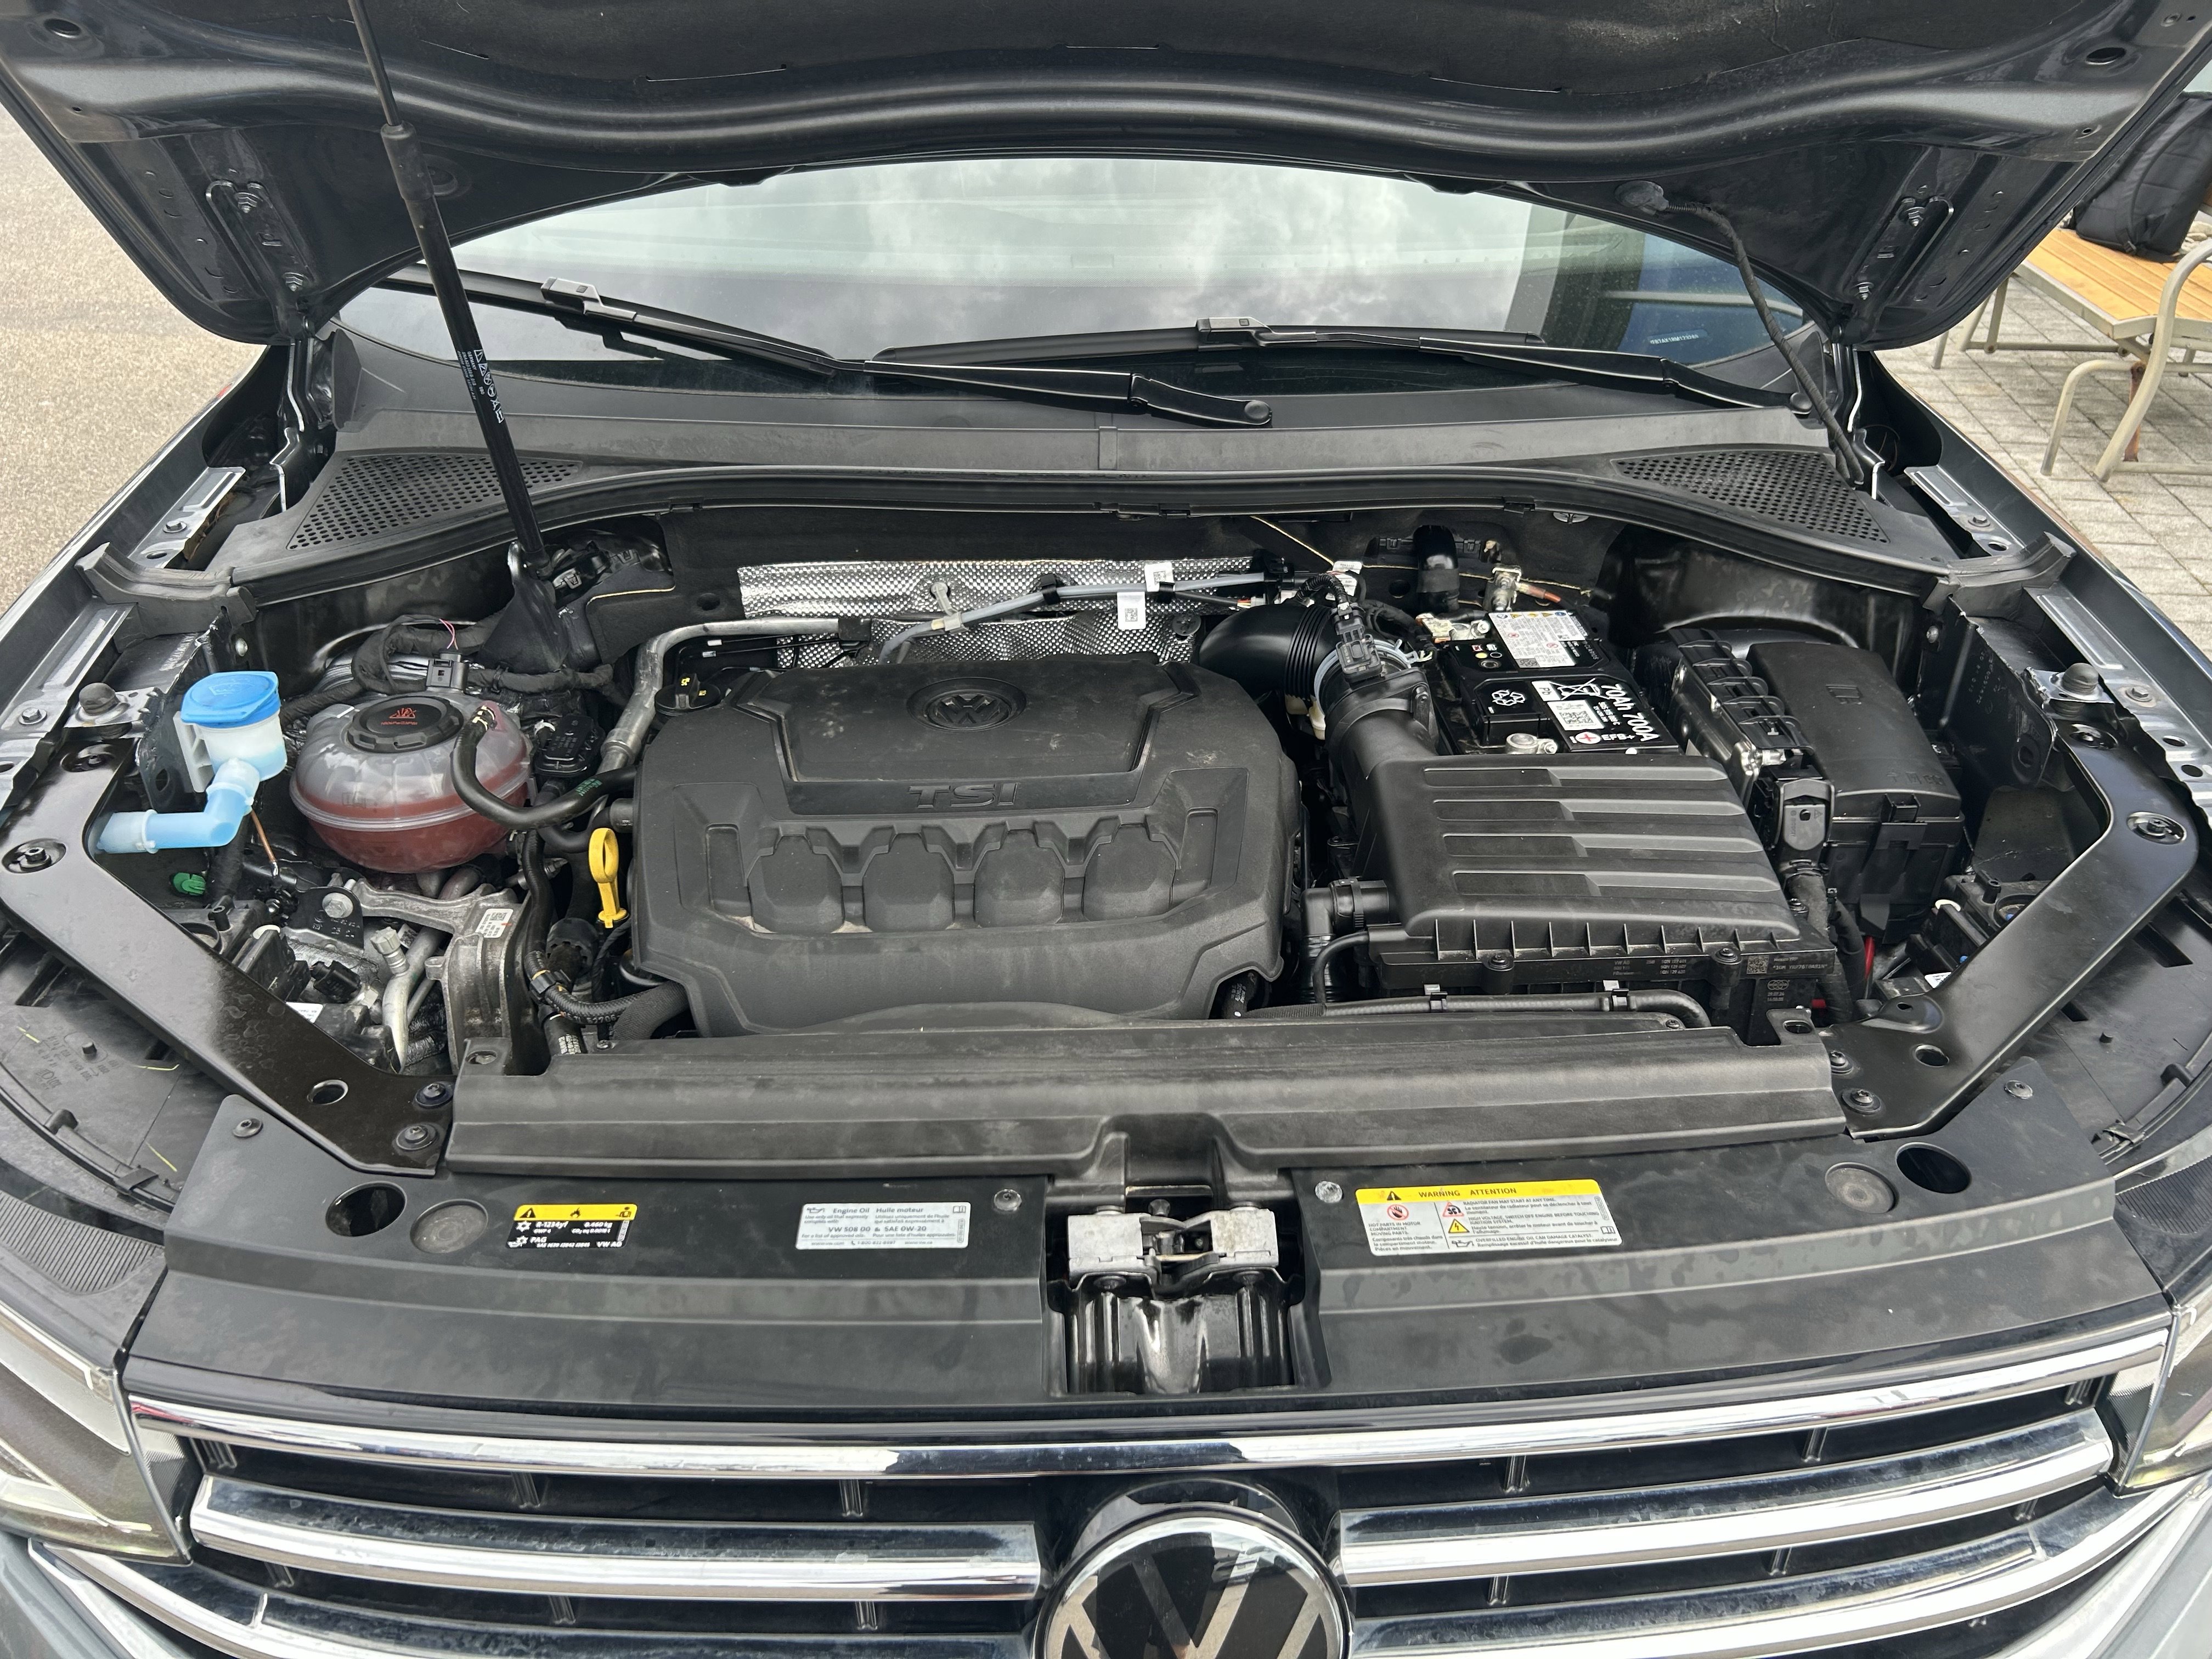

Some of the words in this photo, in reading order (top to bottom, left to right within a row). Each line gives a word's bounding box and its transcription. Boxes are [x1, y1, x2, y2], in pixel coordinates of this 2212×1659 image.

[1601, 684, 1635, 710] 70Ah
[1622, 713, 1660, 741] 700A
[907, 782, 1019, 809] TSI
[1418, 1189, 1460, 1198] WARNING
[1470, 1188, 1517, 1196] ATTENTION
